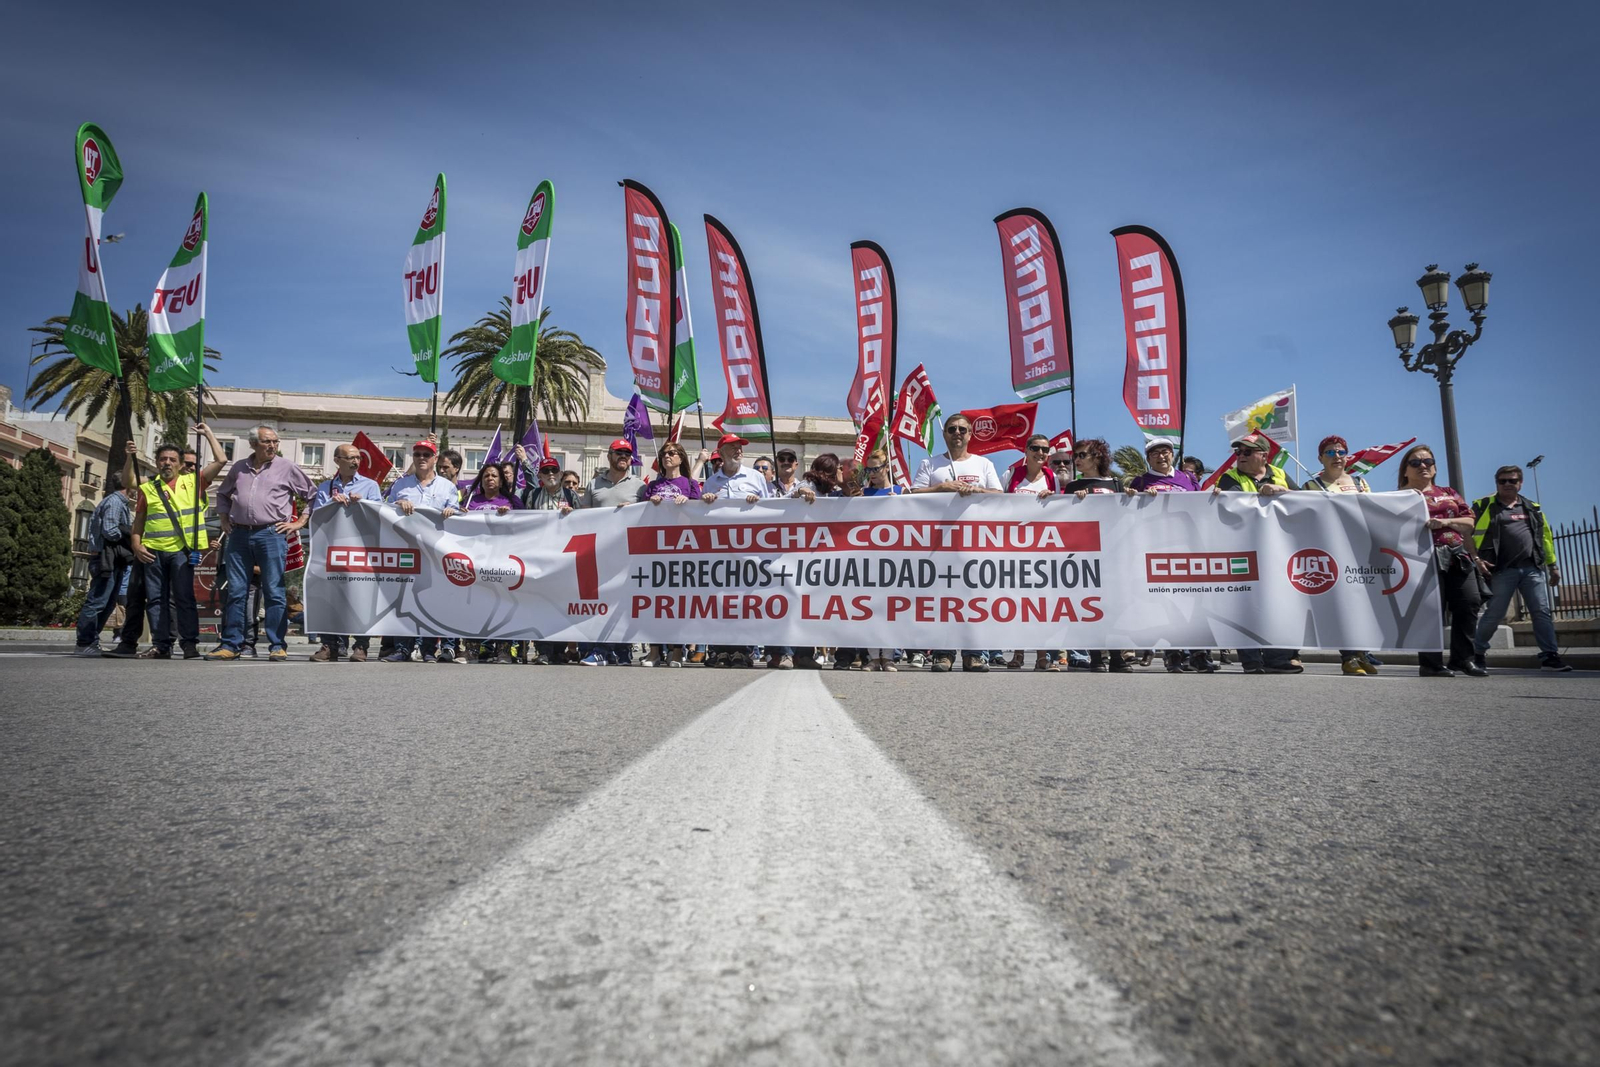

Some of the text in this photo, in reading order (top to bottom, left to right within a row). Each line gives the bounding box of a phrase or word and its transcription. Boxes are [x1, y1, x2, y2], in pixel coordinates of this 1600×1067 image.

[656, 521, 1065, 550] LA LUCHA CONTINÚA
[330, 550, 398, 567] CCOO
[444, 557, 470, 572] UGT
[562, 533, 599, 600] 1
[1292, 556, 1331, 574] UGT
[479, 567, 516, 576] Andalucía
[1150, 558, 1228, 576] CCOO
[1344, 564, 1396, 575] Andalucía
[348, 575, 384, 584] provincial
[1148, 586, 1171, 594] unión
[1172, 586, 1212, 595] provincial
[1227, 584, 1252, 593] Cádiz
[568, 603, 608, 615] MAYO
[631, 594, 1104, 623] PRIMERO LAS PERSONAS
